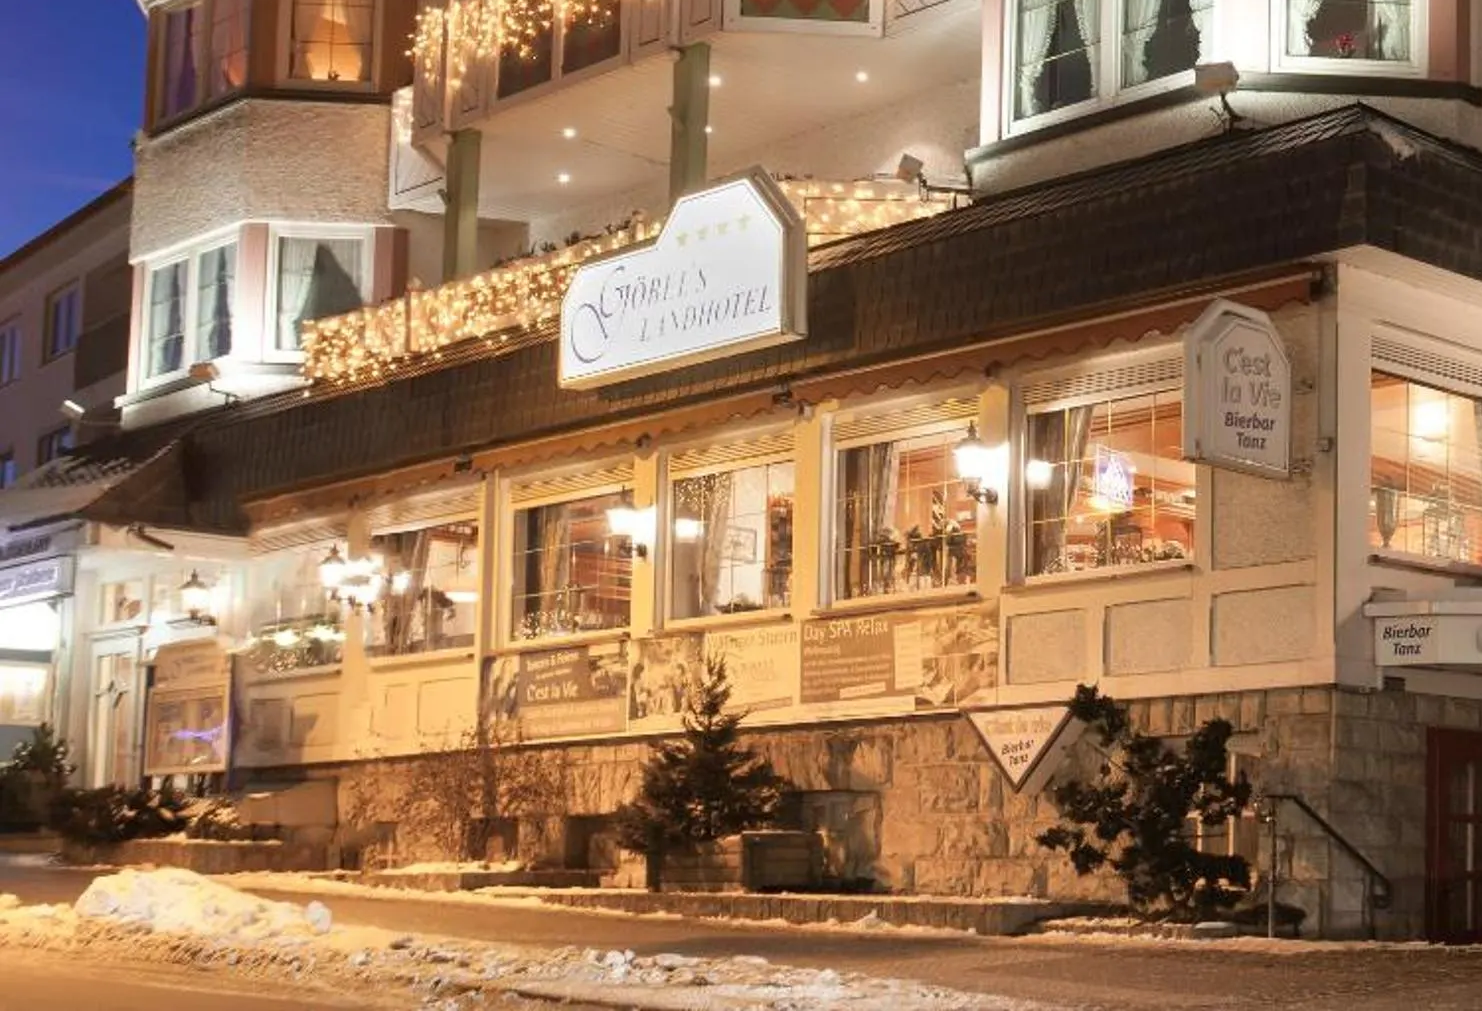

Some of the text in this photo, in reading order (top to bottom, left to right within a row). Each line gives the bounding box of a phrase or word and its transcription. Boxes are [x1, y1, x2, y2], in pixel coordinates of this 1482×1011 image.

[640, 284, 772, 342] LANDHOTEL
[1223, 347, 1272, 378] C'est
[1222, 376, 1282, 408] la Vie
[1224, 411, 1275, 432] Bierbar
[1236, 431, 1266, 450] Tanz
[829, 620, 853, 639] SPA
[1383, 623, 1432, 640] Bierbar
[1393, 642, 1421, 656] Tanz
